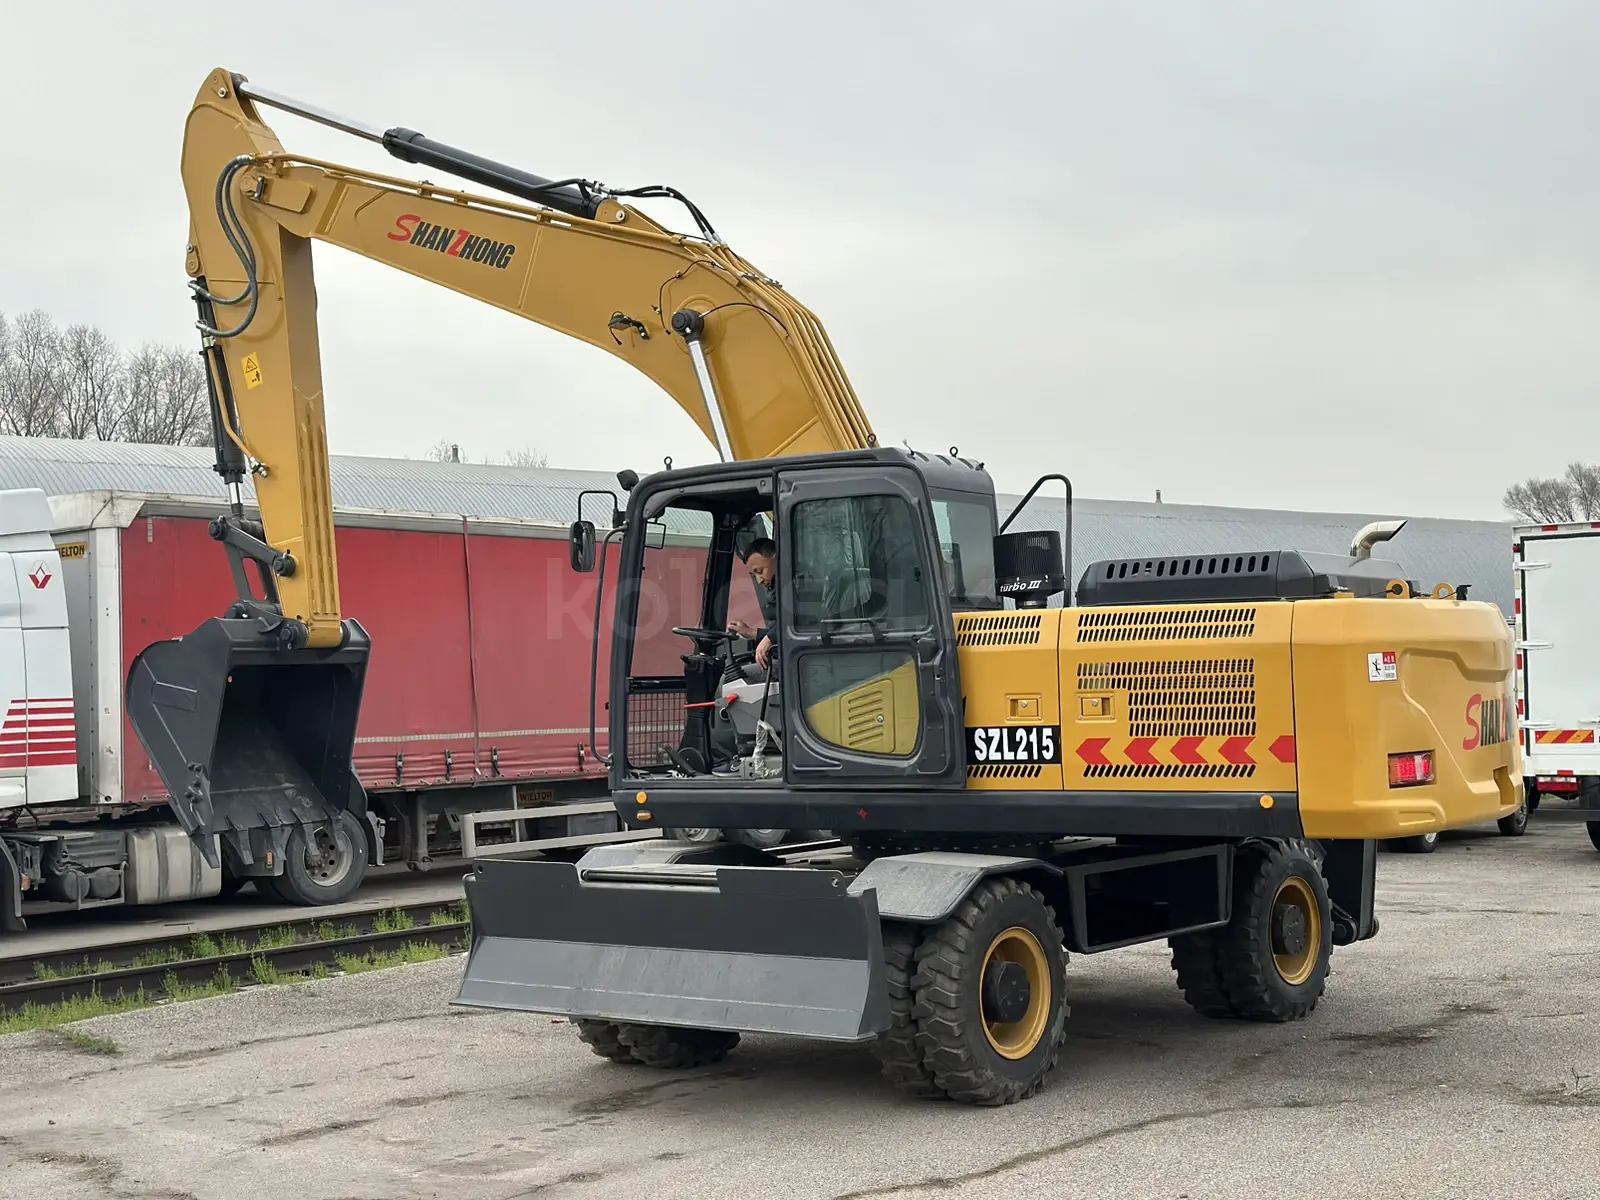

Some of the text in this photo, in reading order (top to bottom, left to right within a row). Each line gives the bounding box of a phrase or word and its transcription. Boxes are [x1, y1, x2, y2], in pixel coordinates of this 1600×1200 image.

[387, 214, 516, 270] SHANZHONG
[1000, 581, 1027, 592] turbo
[974, 727, 1054, 761] SZL215
[519, 791, 553, 802] WIELTON
